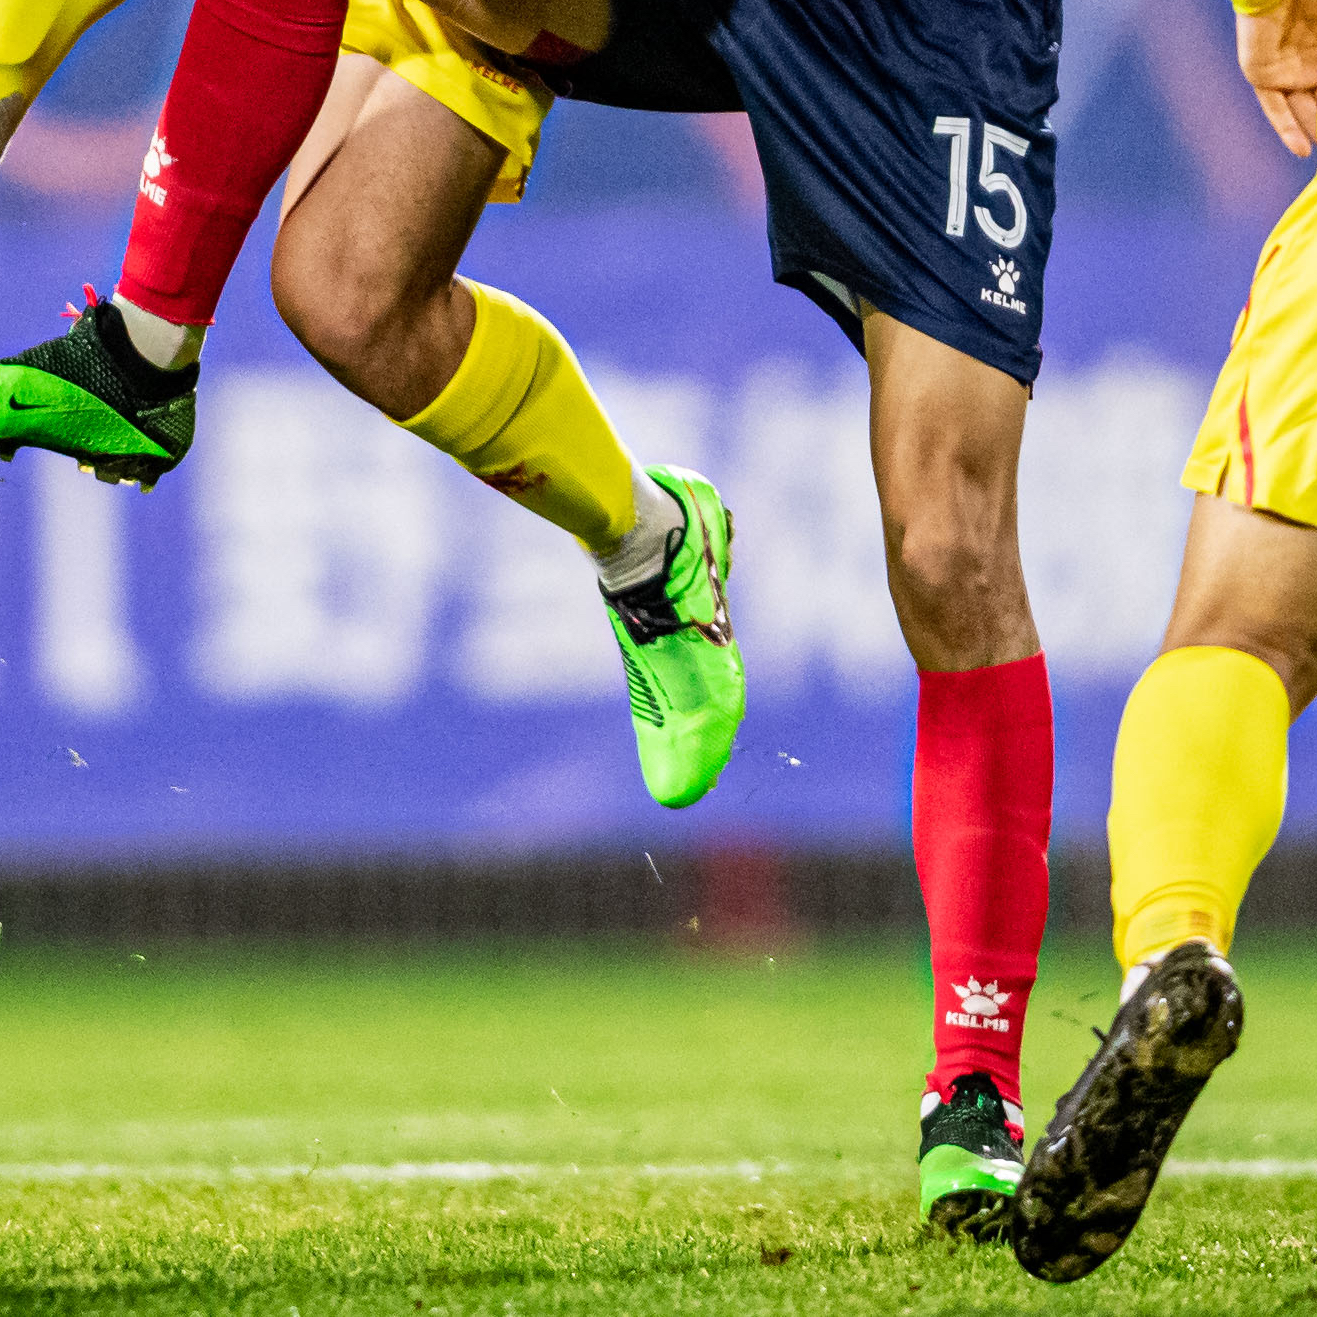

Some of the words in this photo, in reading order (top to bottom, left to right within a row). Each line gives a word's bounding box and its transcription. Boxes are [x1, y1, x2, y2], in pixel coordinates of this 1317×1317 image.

[933, 115, 1031, 249] 15
[980, 287, 1027, 315] KELME
[945, 1011, 1010, 1032] KELME
